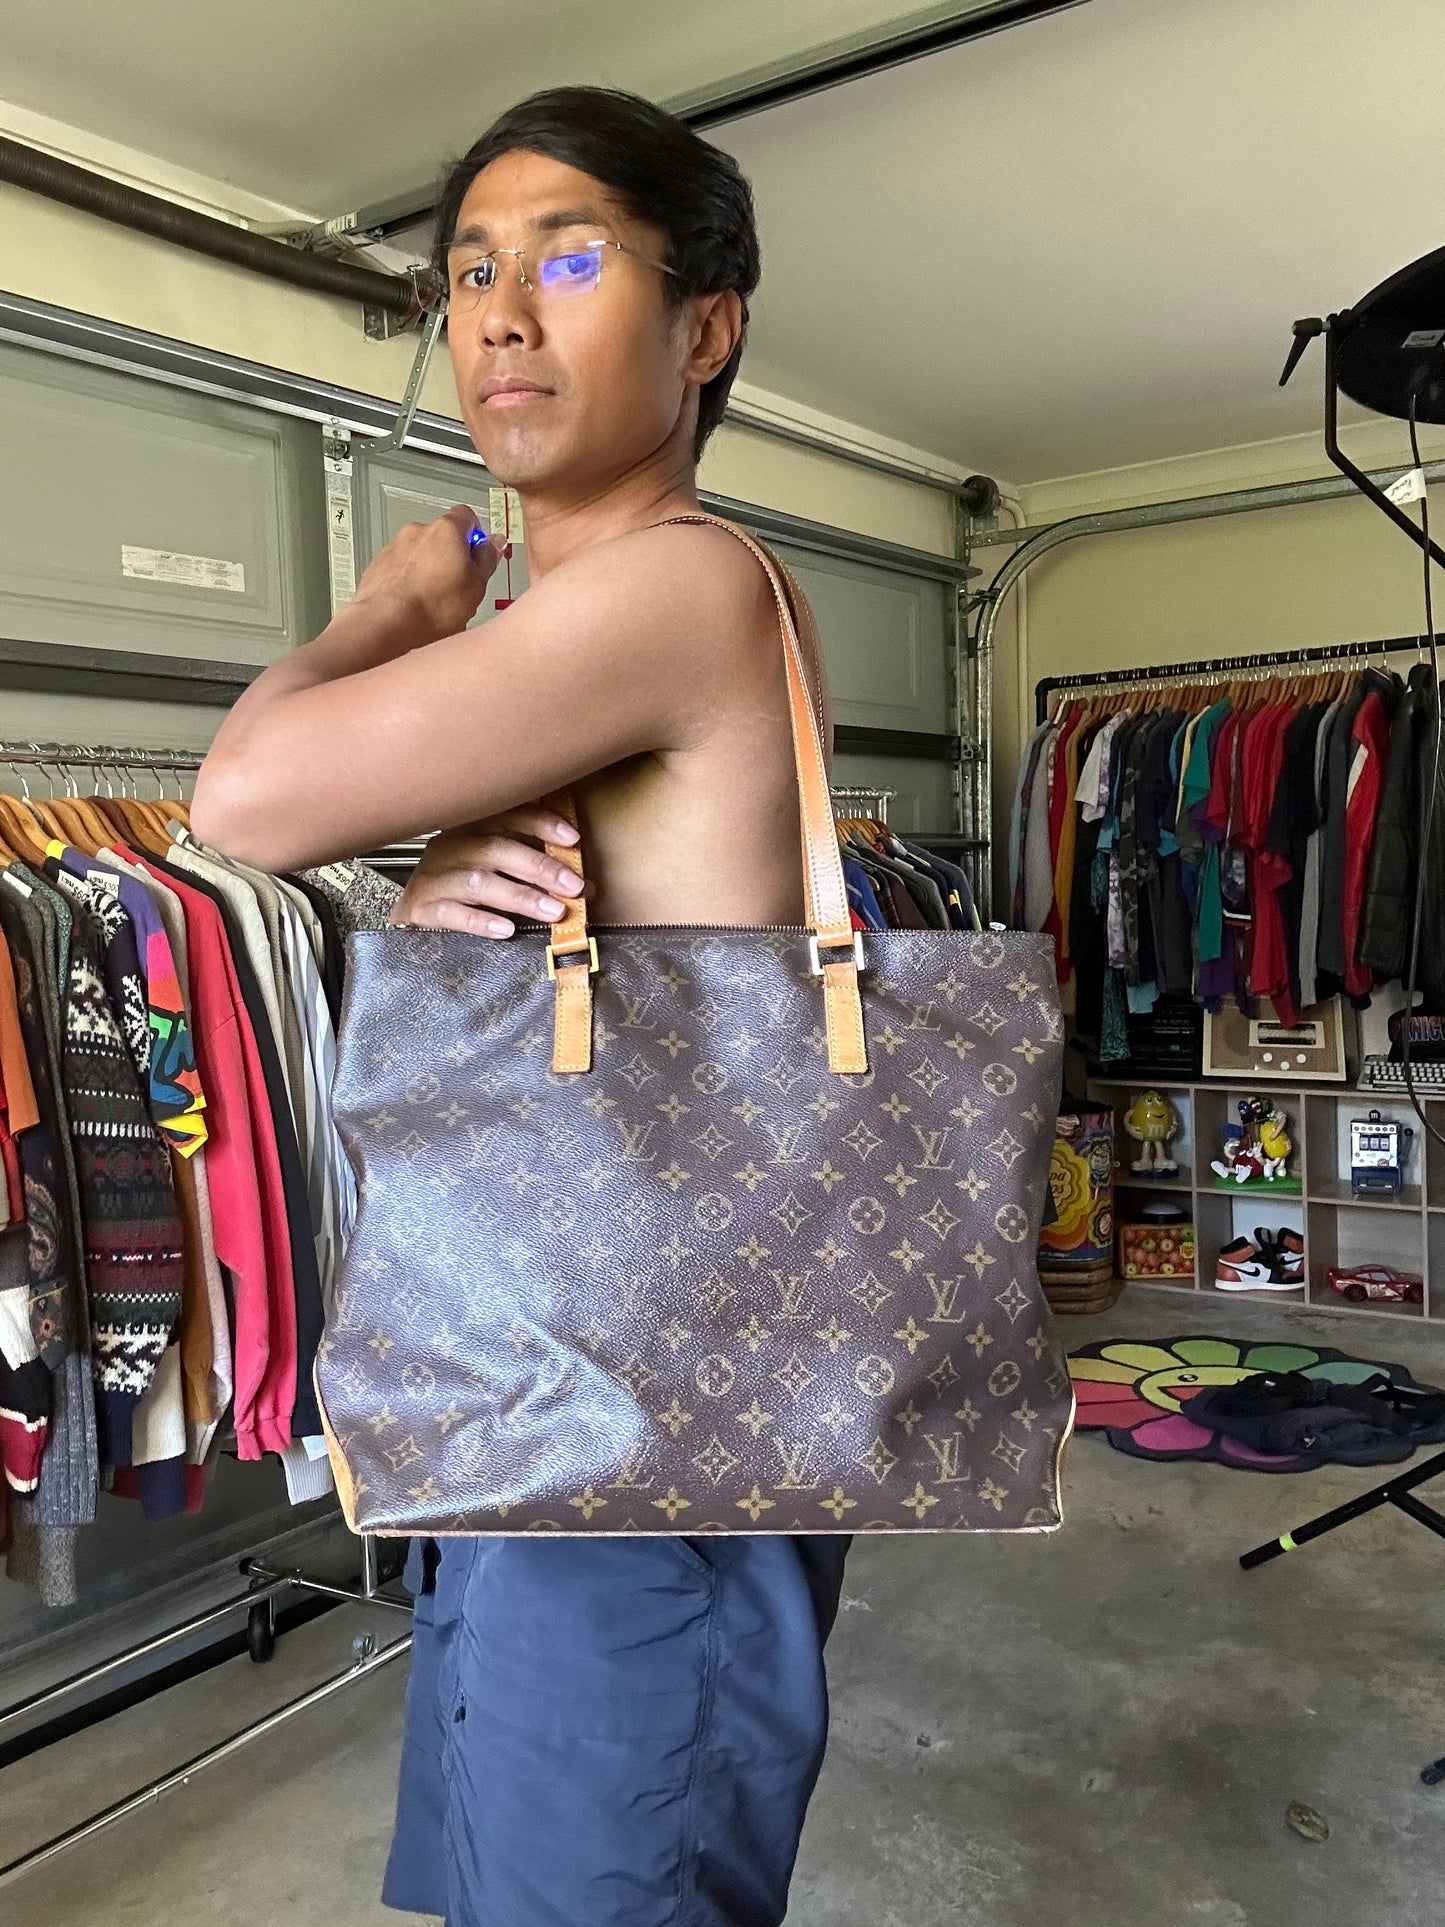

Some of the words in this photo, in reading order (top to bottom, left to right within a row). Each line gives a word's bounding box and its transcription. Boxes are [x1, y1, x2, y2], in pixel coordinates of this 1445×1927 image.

[335, 873, 351, 886] $90
[911, 1124, 956, 1170] LV
[923, 1272, 967, 1323] LV
[922, 1432, 971, 1484] LV
